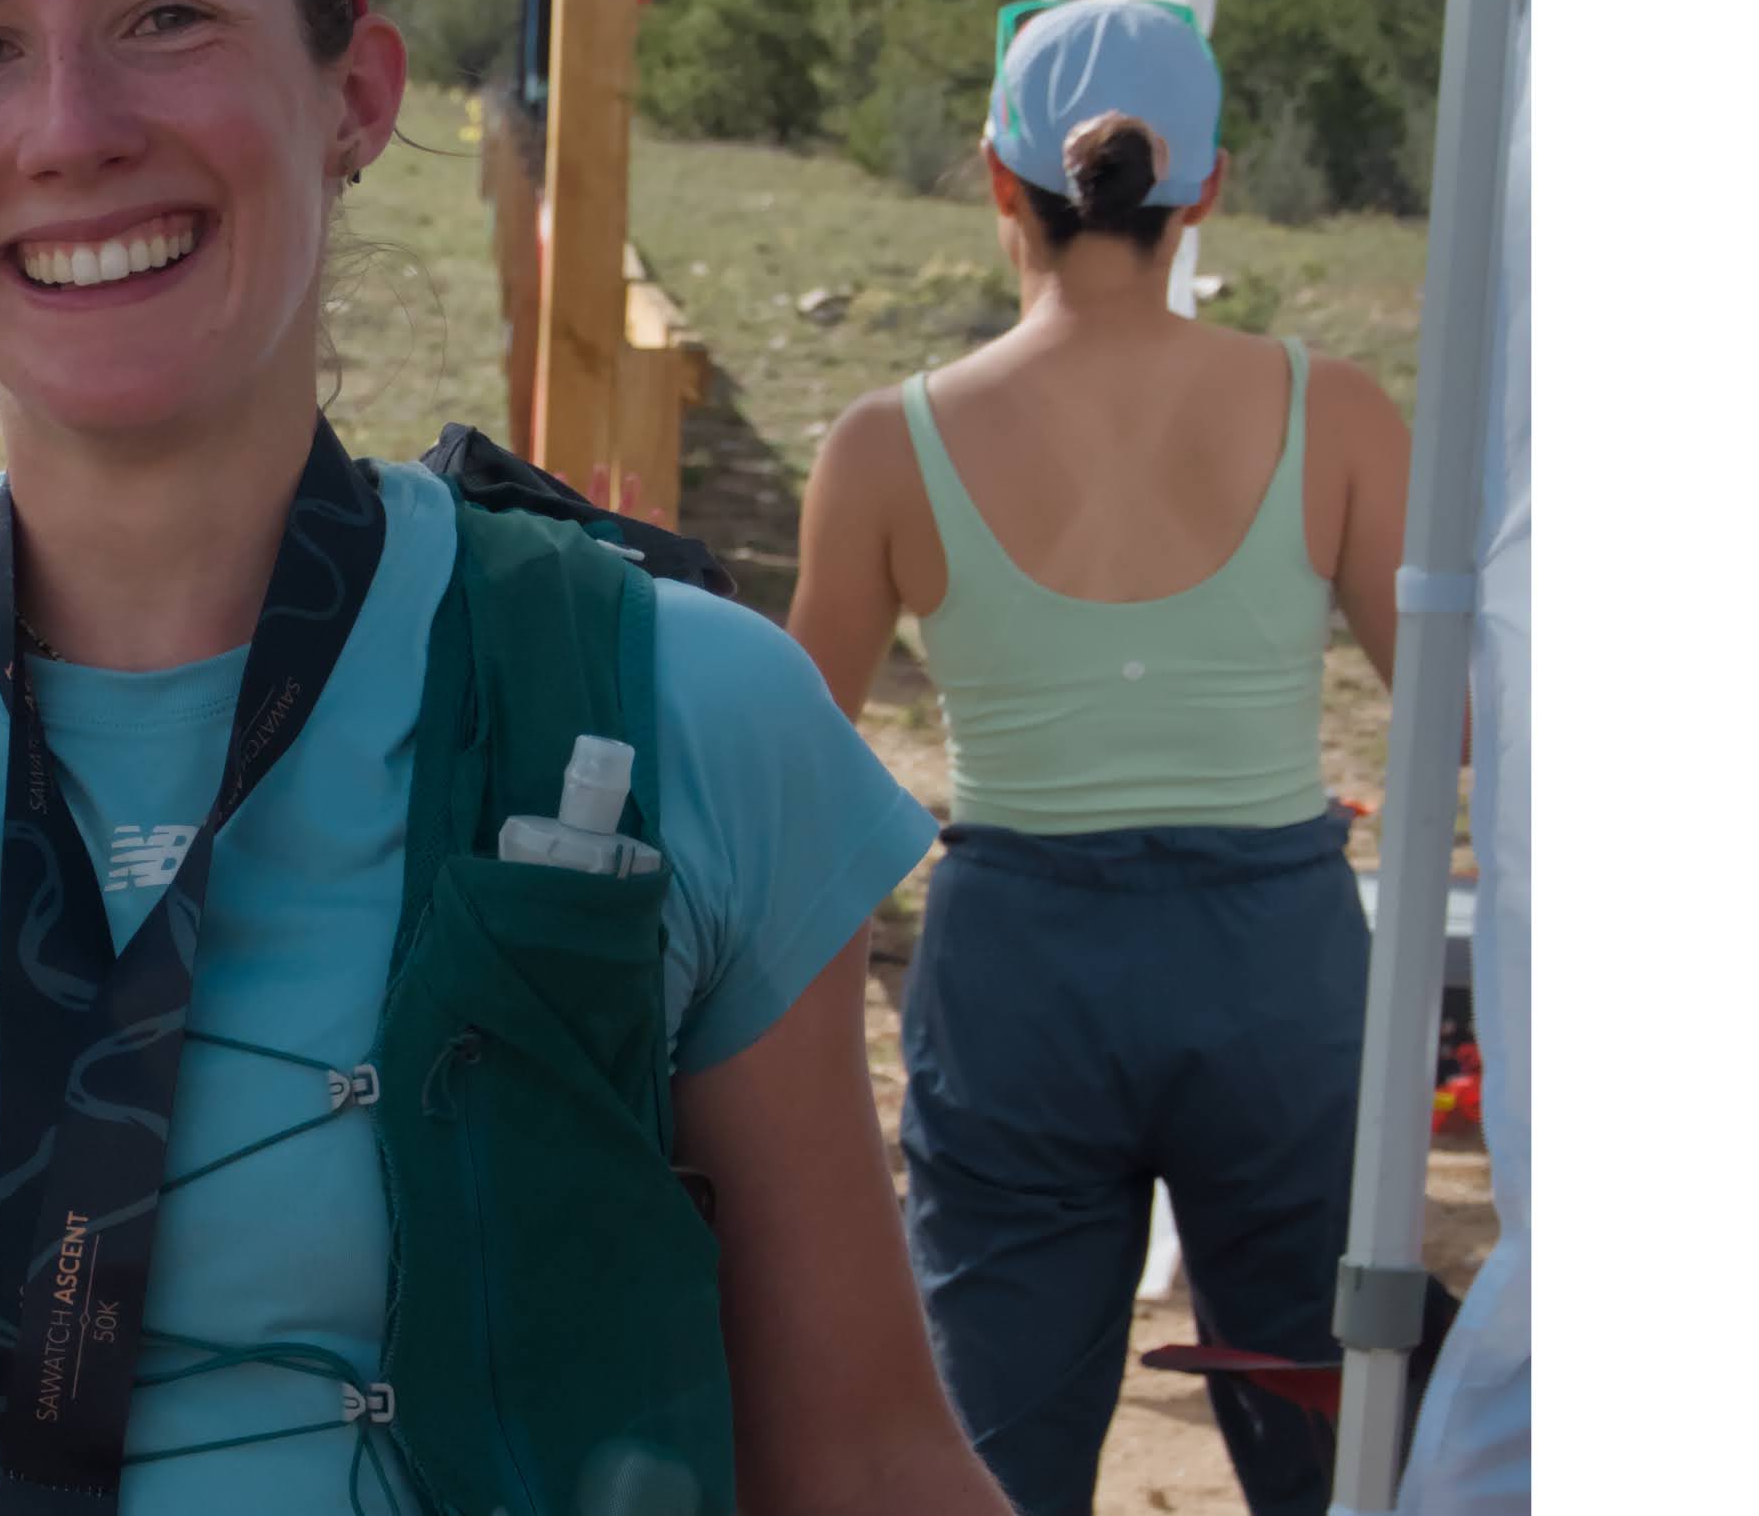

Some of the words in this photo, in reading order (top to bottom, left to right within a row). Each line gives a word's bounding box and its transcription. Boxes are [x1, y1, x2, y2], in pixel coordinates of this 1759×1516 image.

[53, 1210, 89, 1306] ASCENT
[36, 1309, 72, 1421] SAWATCH
[94, 1299, 120, 1342] 50K
